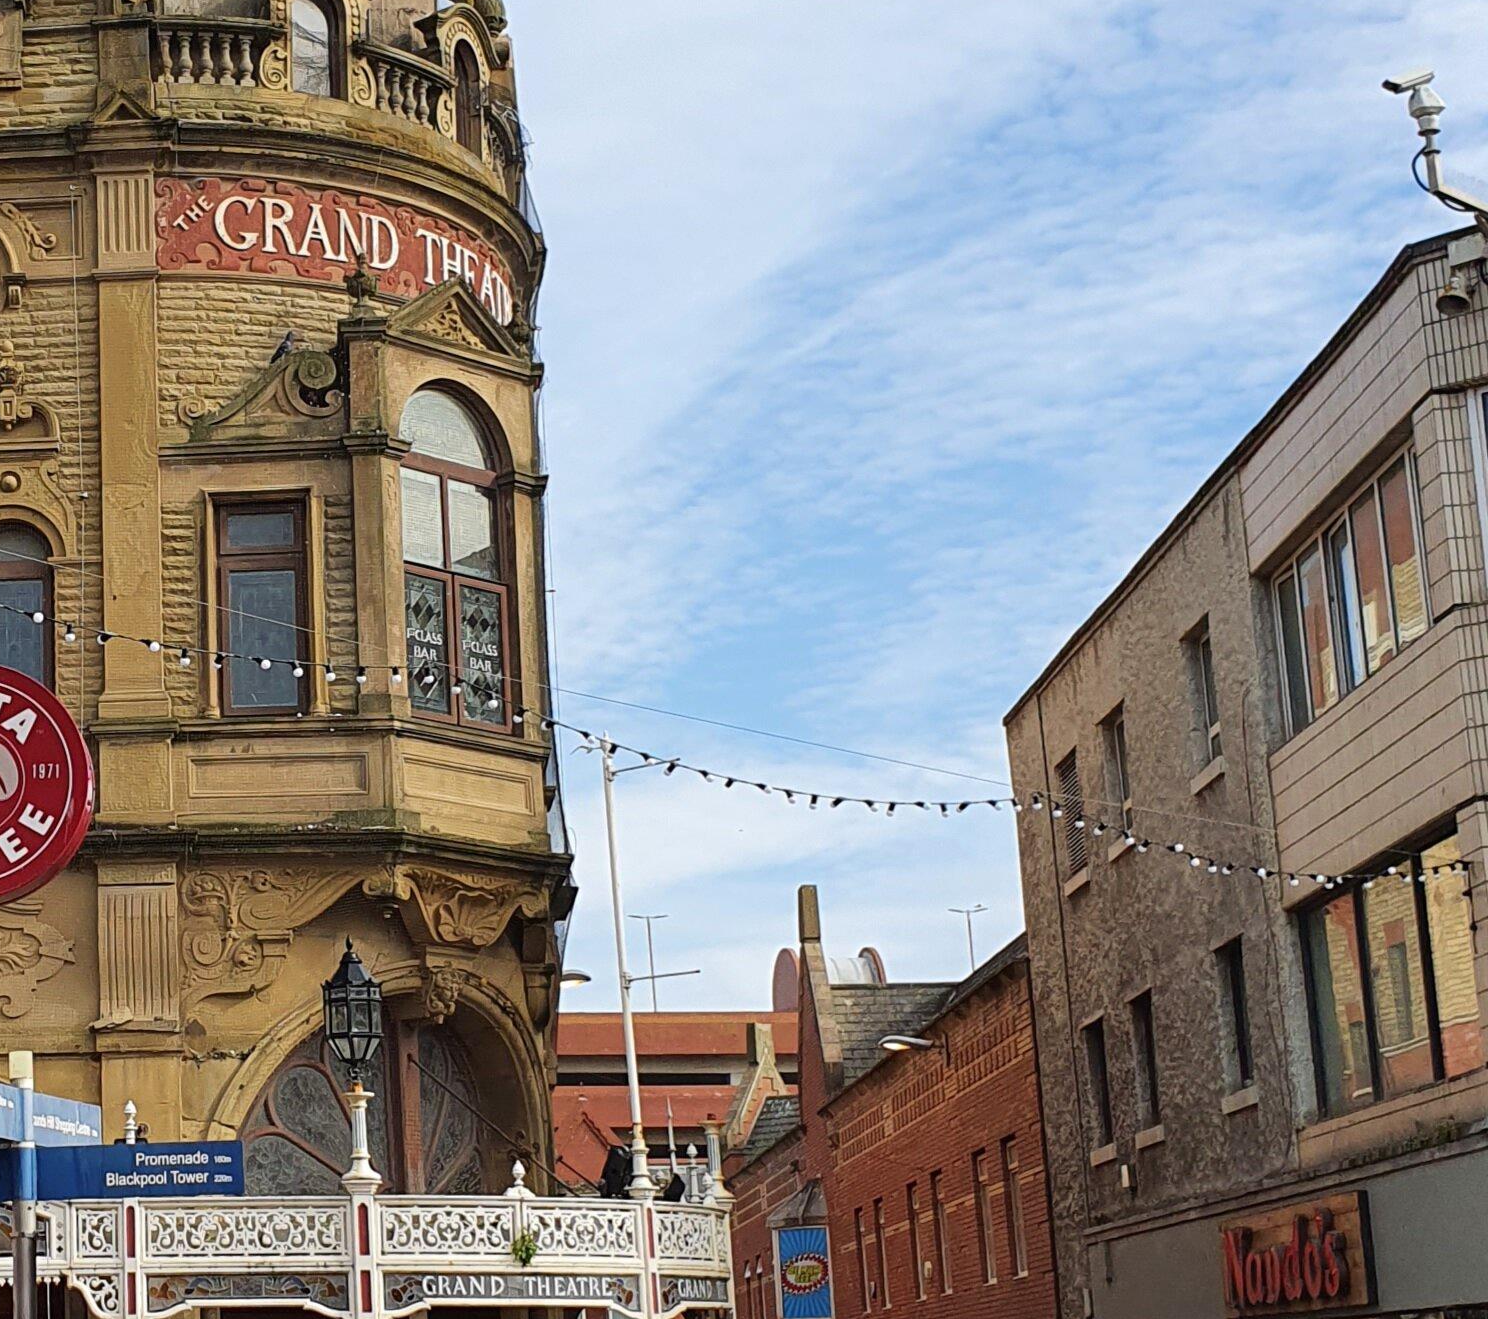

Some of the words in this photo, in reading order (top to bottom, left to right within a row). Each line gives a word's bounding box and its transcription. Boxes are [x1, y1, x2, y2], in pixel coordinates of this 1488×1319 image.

[172, 195, 215, 232] THE
[214, 195, 400, 271] GRAND
[415, 629, 444, 646] CLASS
[414, 645, 438, 662] BAR
[471, 641, 499, 657] CLASS
[470, 656, 492, 673] BAR
[32, 763, 60, 779] 1971
[135, 1151, 209, 1167] Promenade
[106, 1170, 168, 1188] Blackpool
[169, 1169, 210, 1184] Tower
[1223, 1208, 1340, 1309] Nando's
[421, 1274, 507, 1297] GRAND
[522, 1274, 613, 1297] THEATRE
[677, 1279, 713, 1298] GRAND
